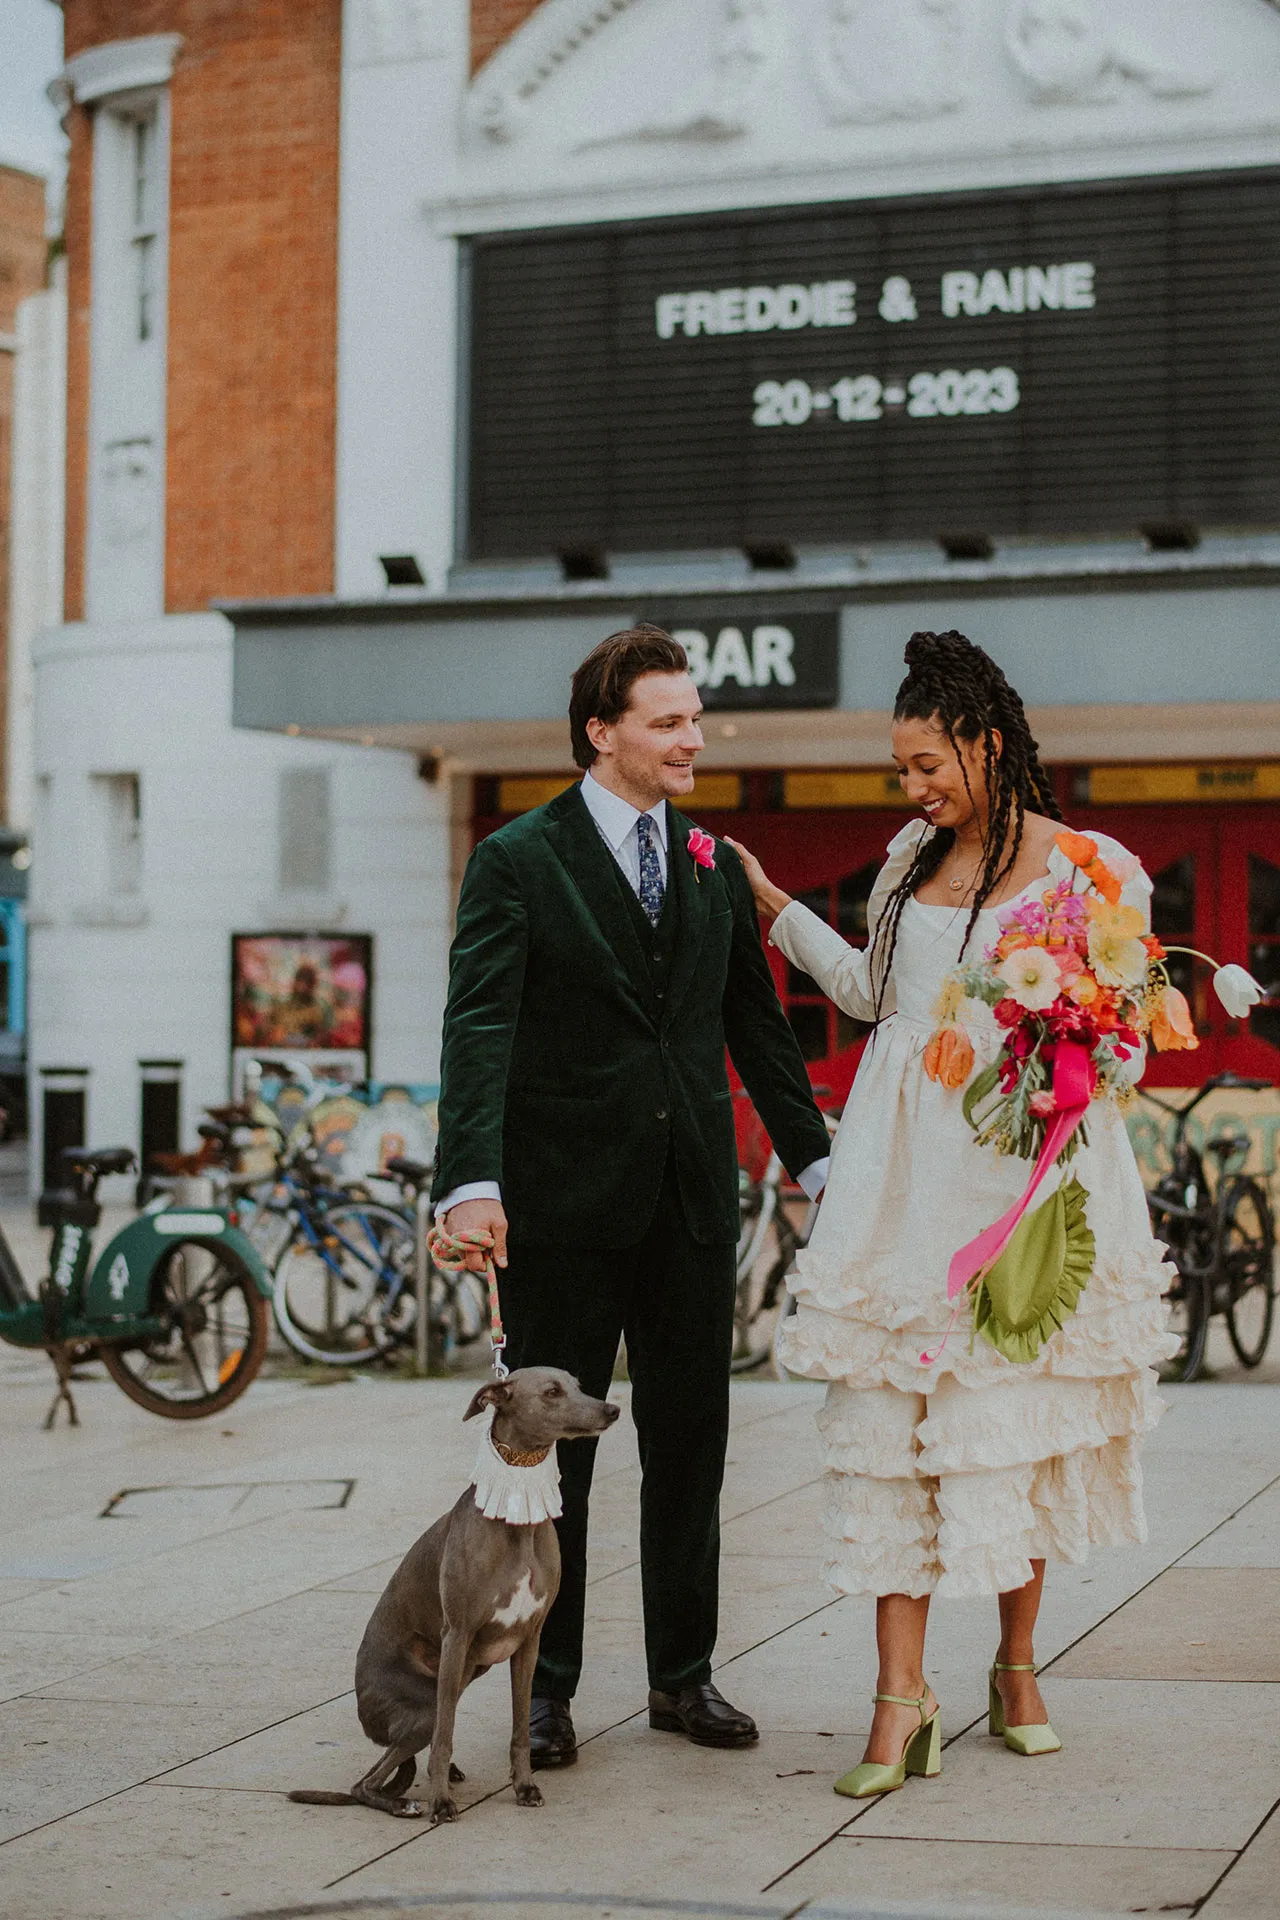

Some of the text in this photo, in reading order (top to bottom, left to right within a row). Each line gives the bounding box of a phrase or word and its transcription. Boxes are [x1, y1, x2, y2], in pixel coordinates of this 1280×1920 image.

[655, 261, 1096, 339] FREDDIE & RAINE
[672, 624, 796, 689] BAR
